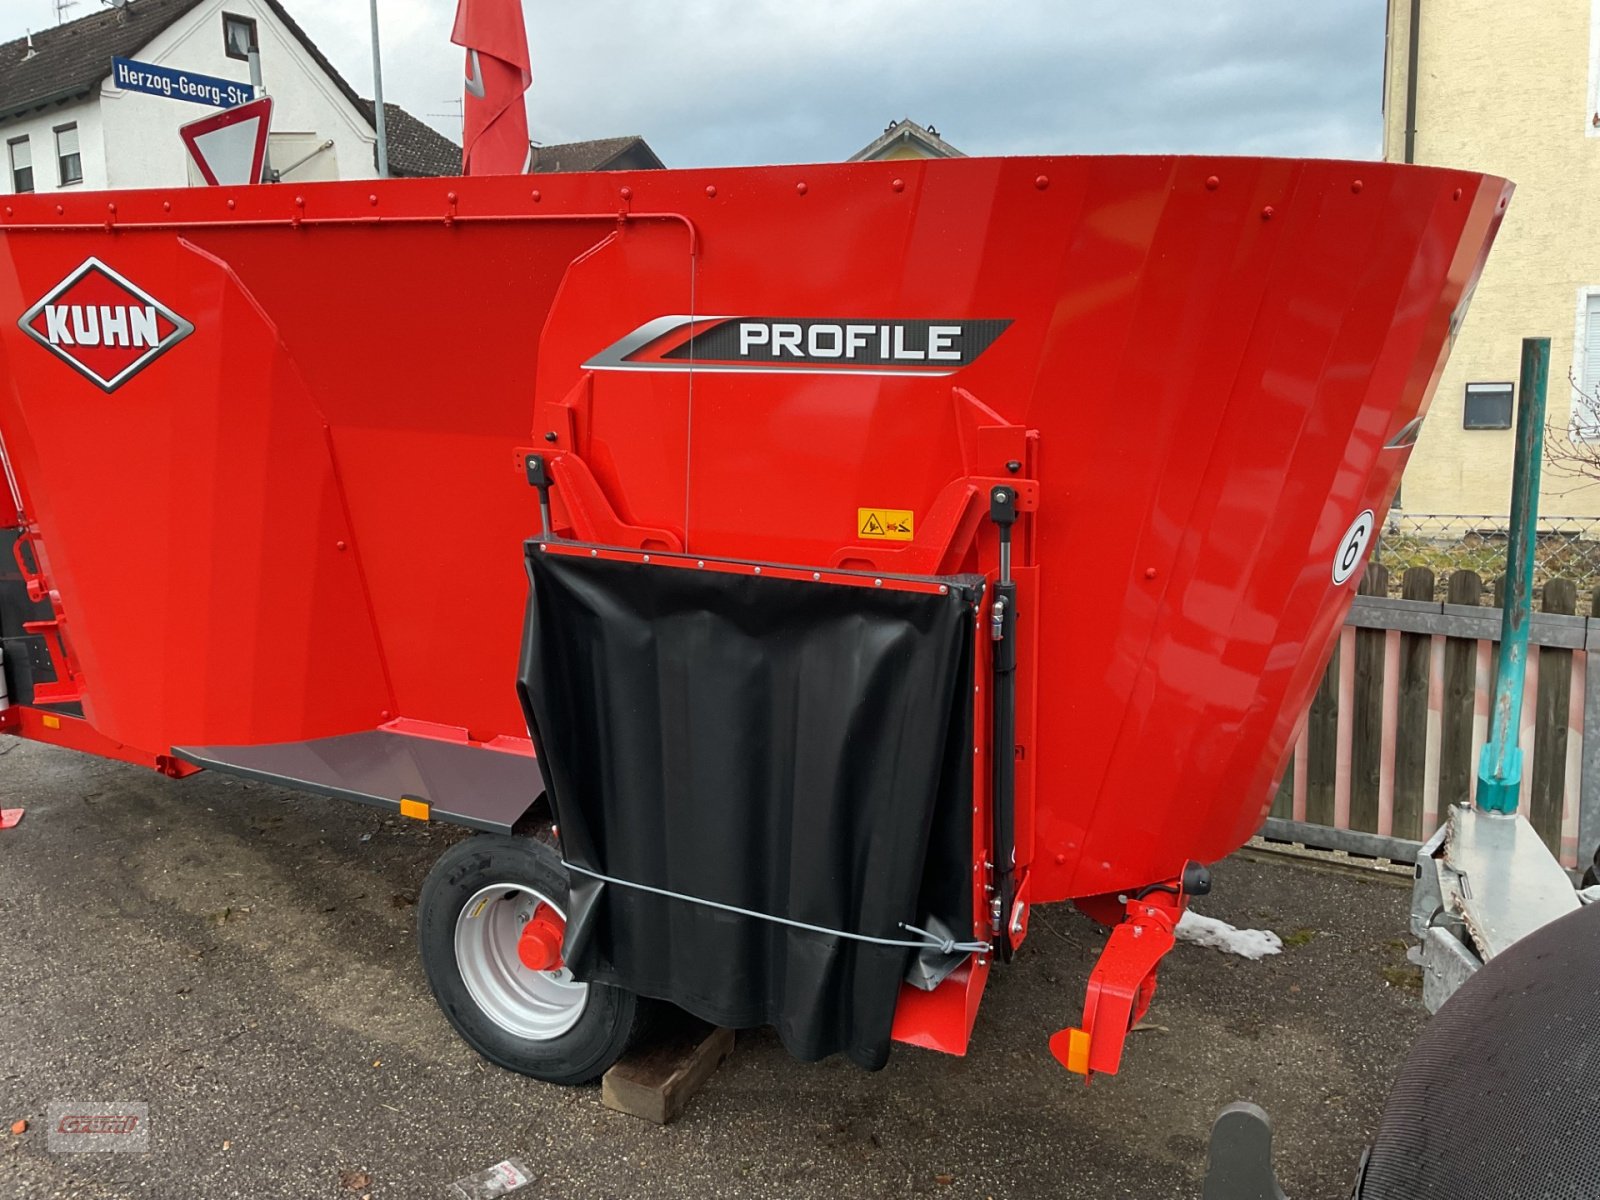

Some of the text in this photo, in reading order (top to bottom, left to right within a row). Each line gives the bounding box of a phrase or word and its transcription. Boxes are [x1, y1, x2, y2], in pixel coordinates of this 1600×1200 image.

[45, 305, 160, 348] KUHN
[739, 322, 963, 361] PROFILE
[1342, 525, 1365, 571] 6
